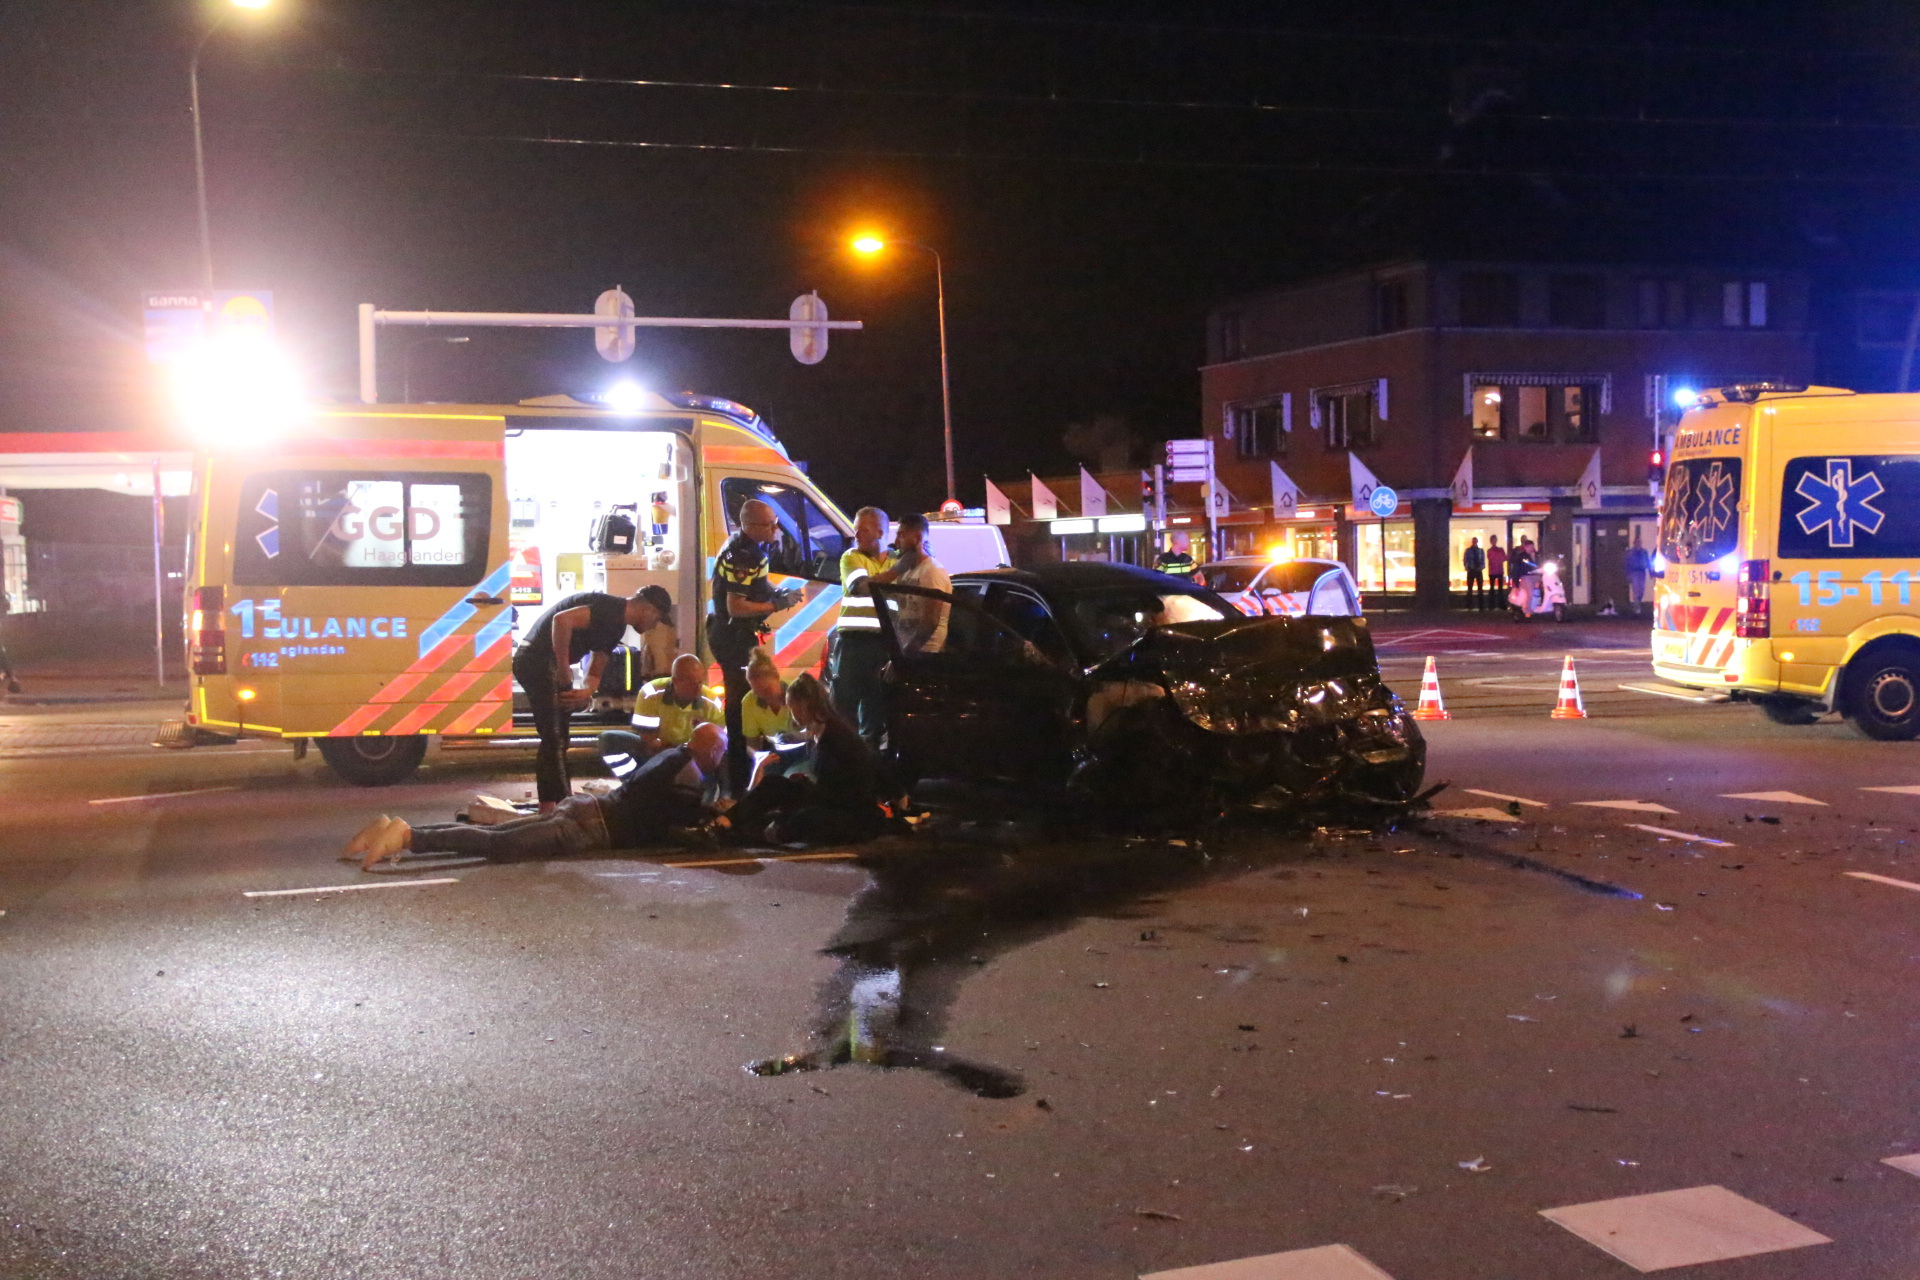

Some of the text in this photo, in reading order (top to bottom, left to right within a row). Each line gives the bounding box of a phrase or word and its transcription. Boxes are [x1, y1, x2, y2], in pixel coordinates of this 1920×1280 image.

[1674, 428, 1741, 449] AMBULANCE
[331, 505, 441, 541] GGD
[364, 547, 464, 565] Haaglanden
[1790, 570, 1920, 606] 15-11
